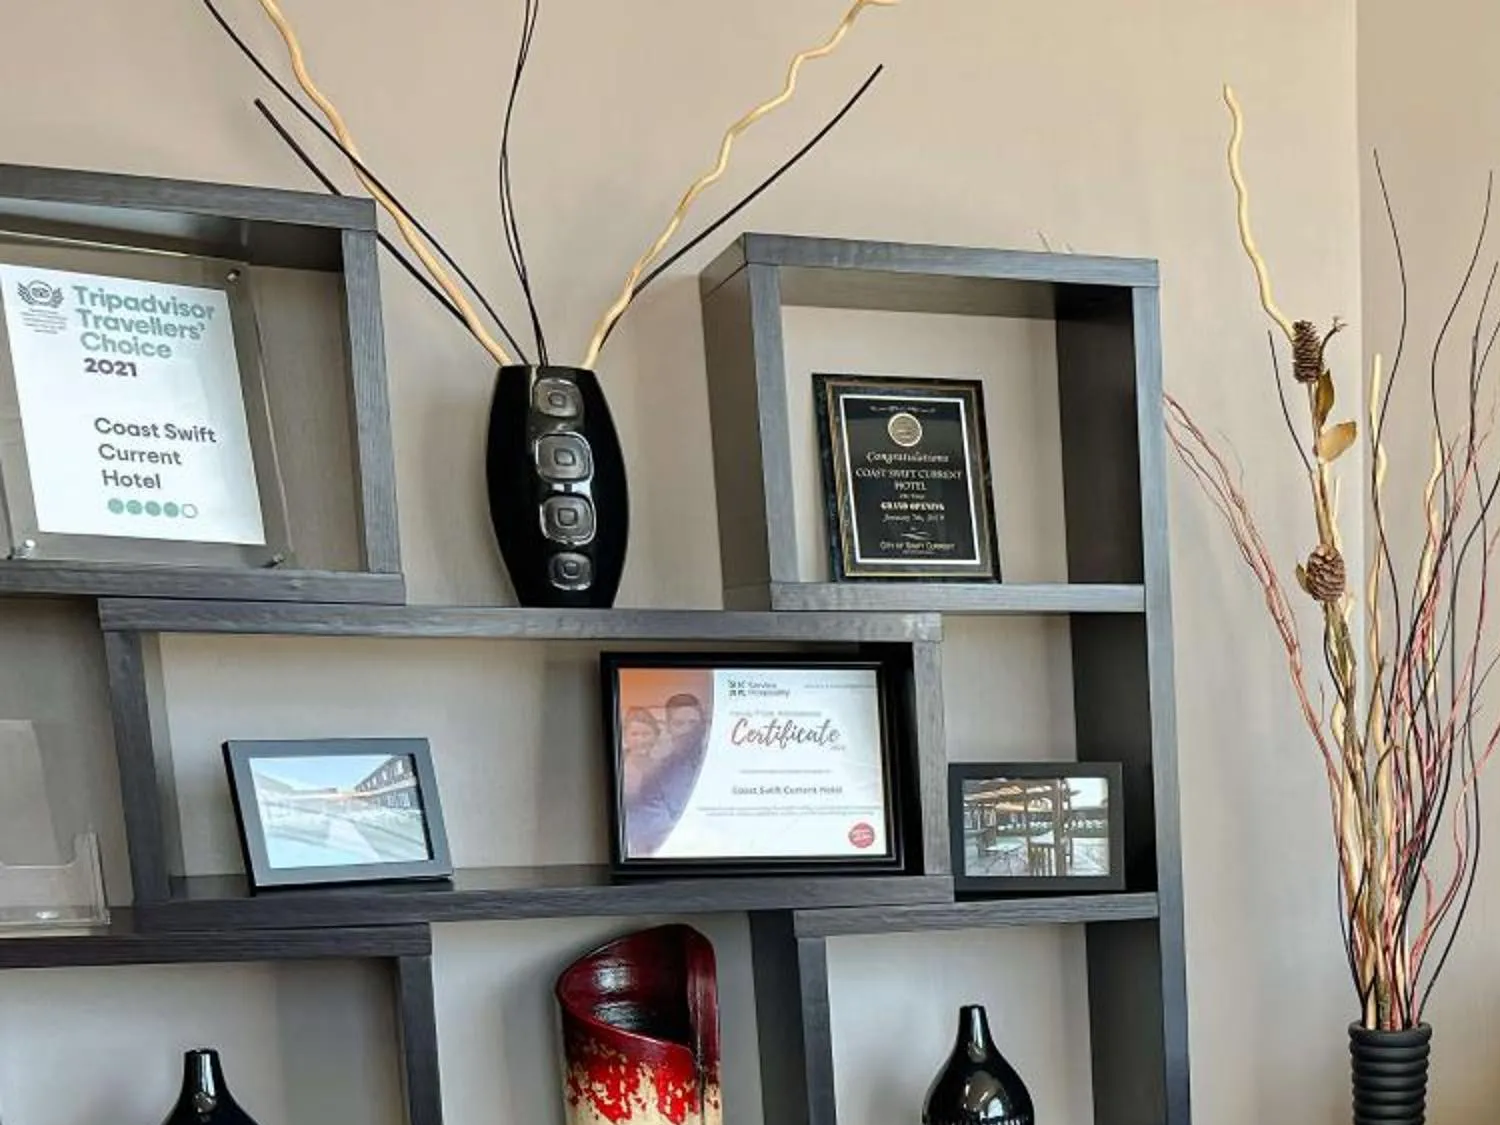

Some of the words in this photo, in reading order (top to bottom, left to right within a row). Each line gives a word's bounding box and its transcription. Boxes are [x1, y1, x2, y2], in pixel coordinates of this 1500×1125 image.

[72, 285, 216, 321] Tripadvisor
[80, 331, 173, 359] Choice
[83, 357, 138, 377] 2021
[94, 416, 161, 438] Coast
[163, 423, 217, 443] Swift
[98, 443, 182, 465] Current
[101, 468, 162, 489] Hotel
[894, 481, 927, 490] HOTEL
[731, 717, 841, 749] Certificate
